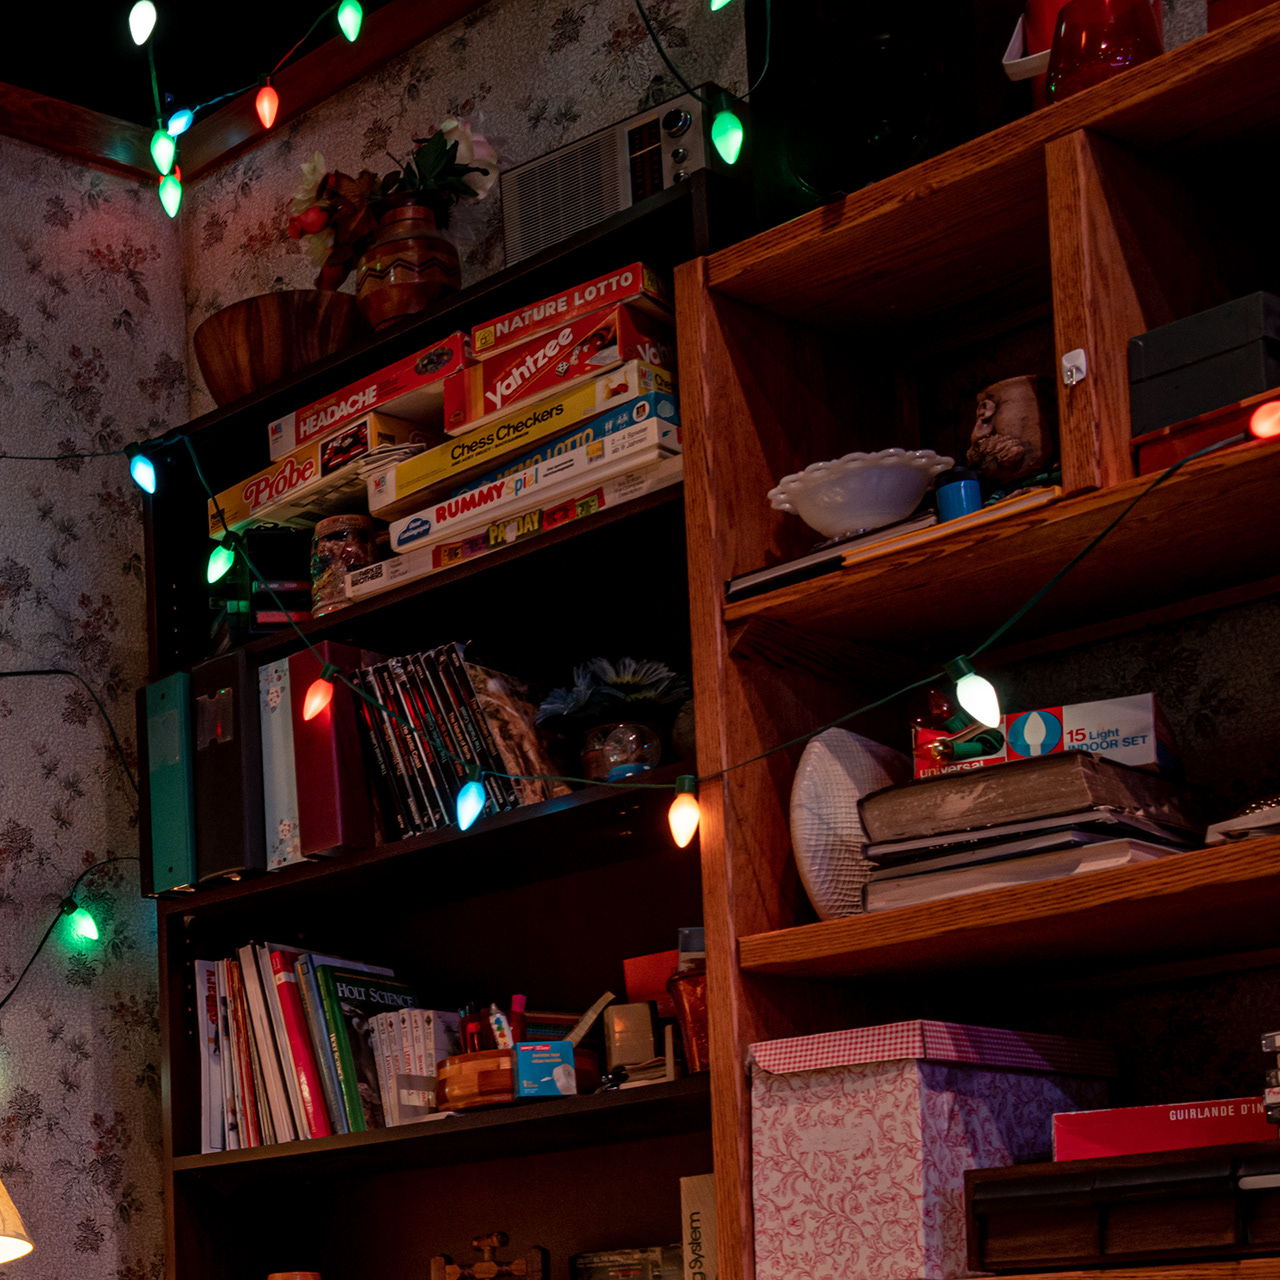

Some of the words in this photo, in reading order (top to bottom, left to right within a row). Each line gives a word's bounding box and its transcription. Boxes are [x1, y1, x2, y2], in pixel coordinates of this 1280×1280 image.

[496, 298, 567, 338] NATURE
[574, 271, 633, 306] LOTTO
[485, 328, 574, 410] Yahtzee
[300, 385, 377, 438] HEADACHE
[451, 430, 495, 461] Chess
[496, 404, 564, 440] Checkers
[243, 458, 315, 511] Probe
[351, 572, 383, 587] BROTHERS
[1065, 728, 1086, 743] 15
[1089, 728, 1120, 742] Light
[1068, 739, 1119, 752] INDOOR
[1122, 735, 1149, 748] SET
[919, 760, 984, 779] universal
[337, 981, 366, 1002] HOLT
[369, 987, 414, 1008] SCIENCE
[1169, 1104, 1235, 1121] GUIRLANDE
[689, 1210, 704, 1271] System
